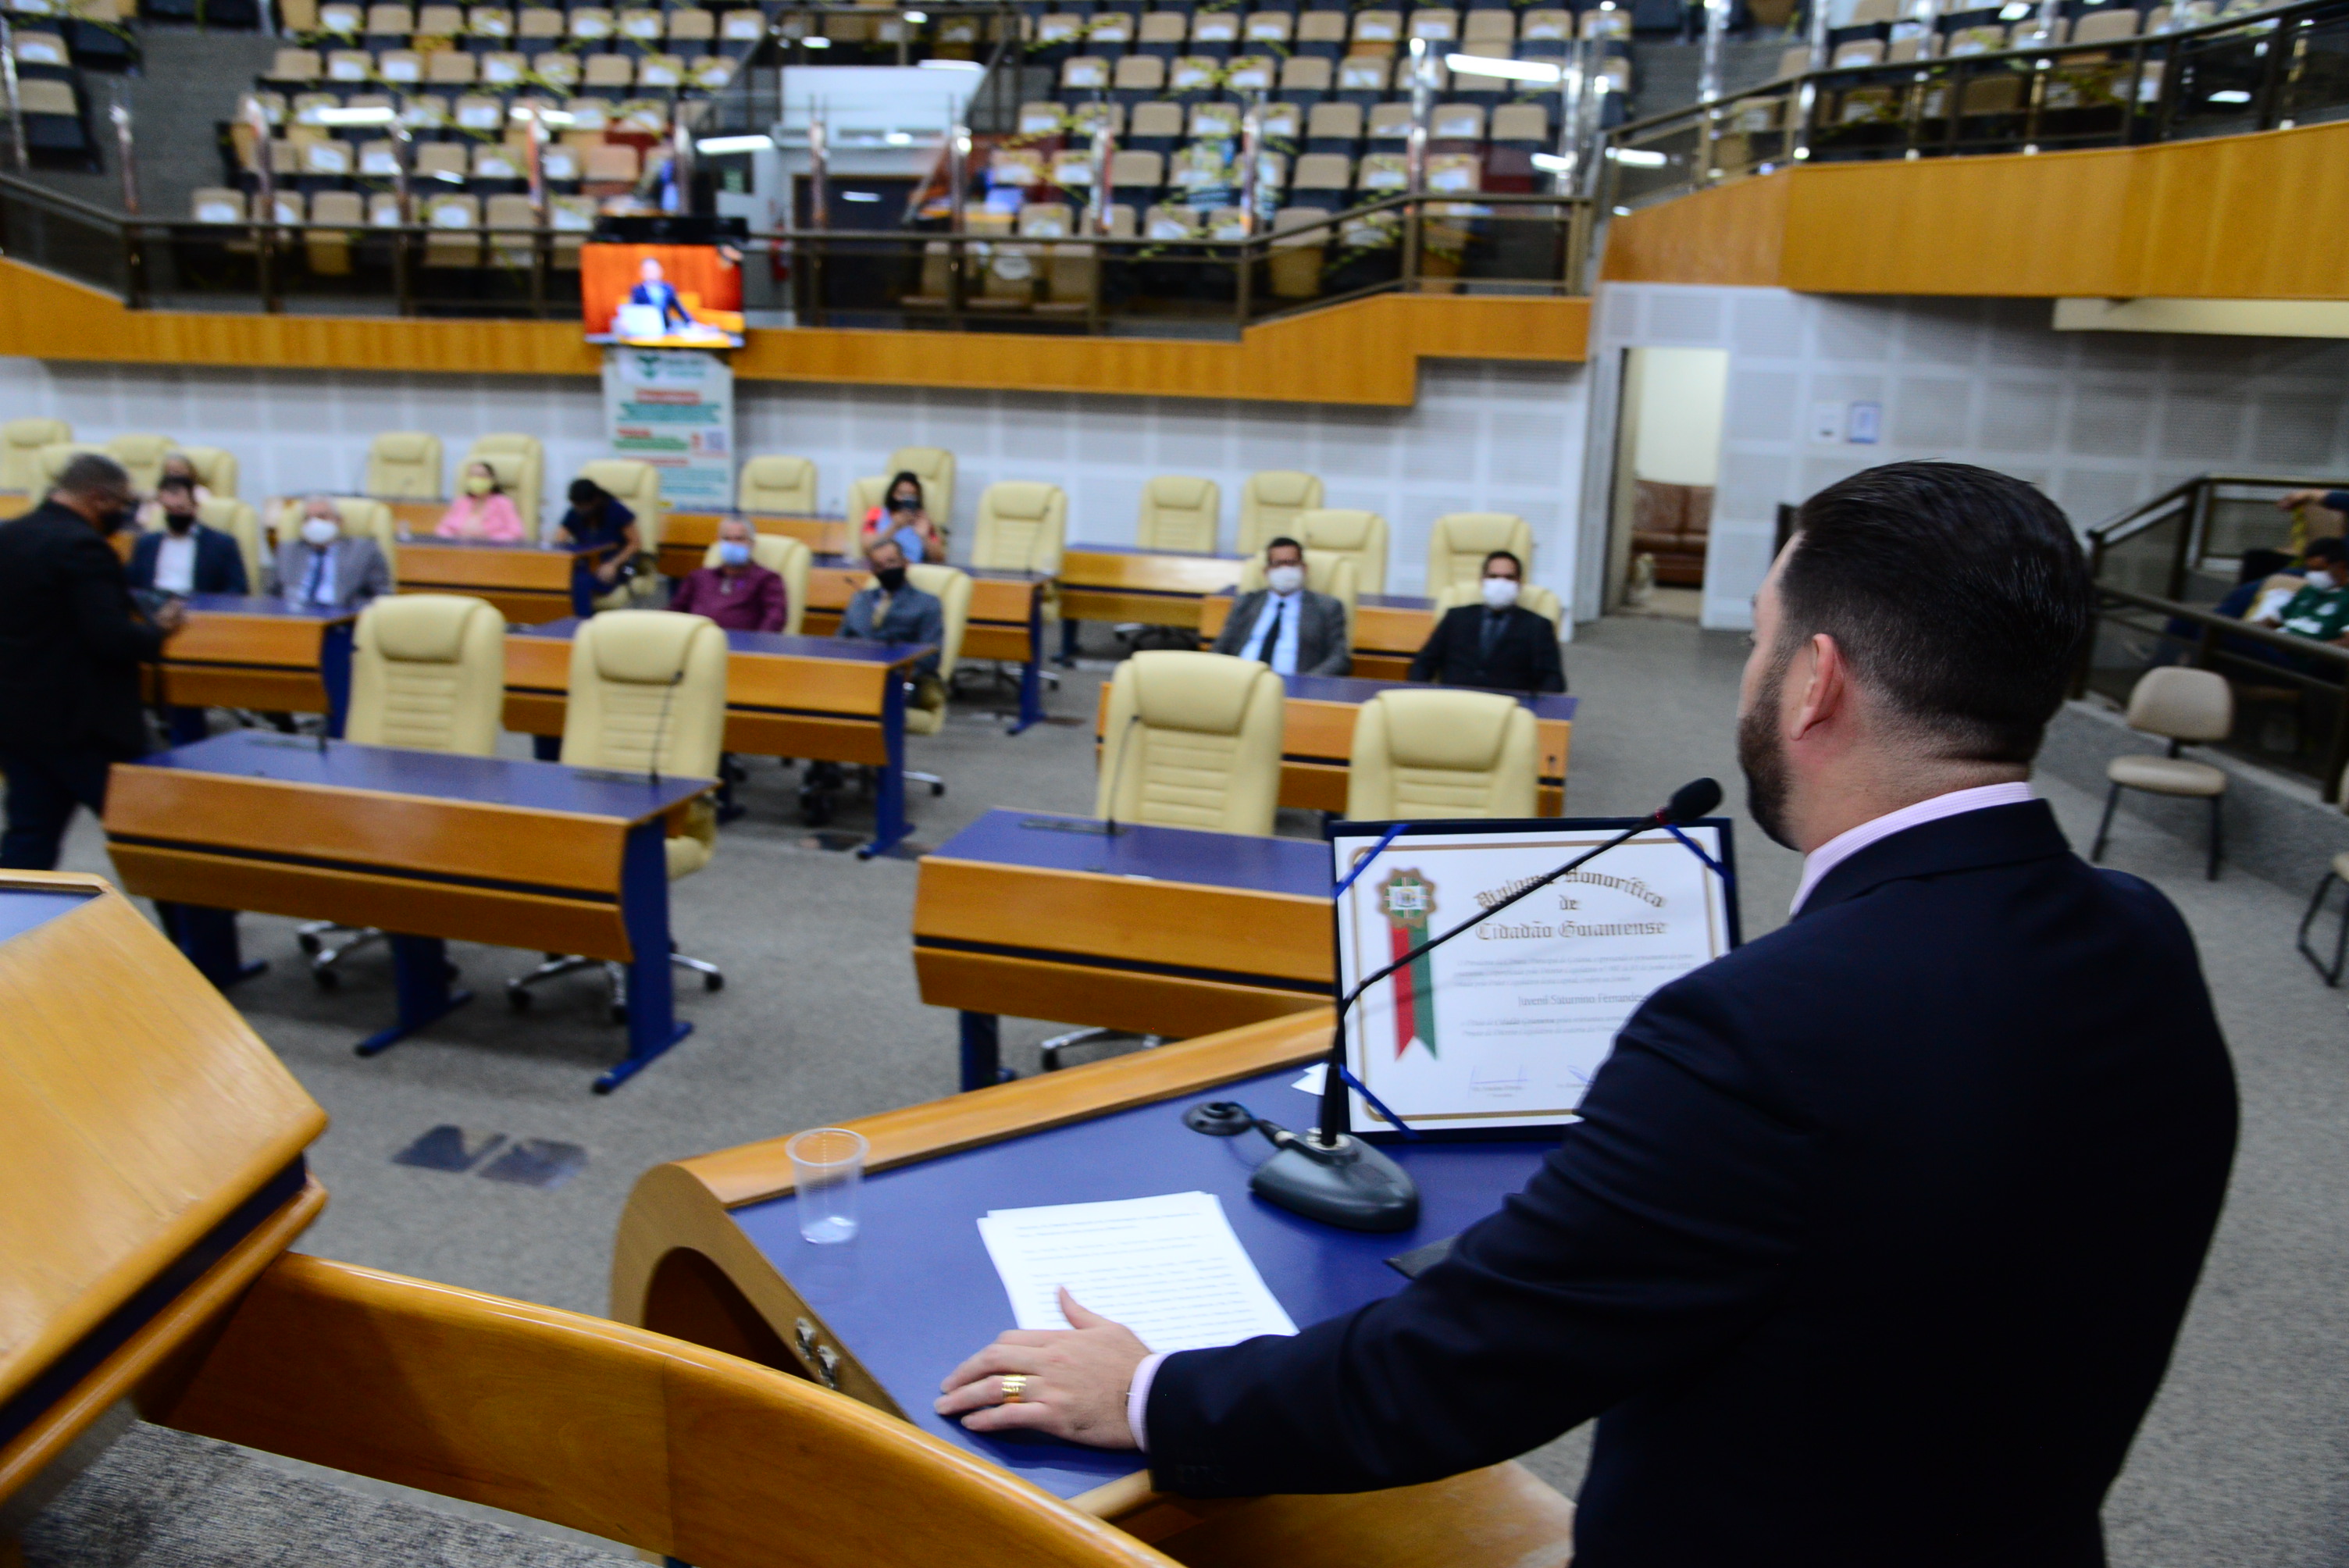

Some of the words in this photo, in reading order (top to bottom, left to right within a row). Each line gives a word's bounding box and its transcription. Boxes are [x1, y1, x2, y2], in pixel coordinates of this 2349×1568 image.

[1473, 875, 1554, 911] Diplom
[1559, 894, 1580, 911] de
[1475, 920, 1552, 940] Cidadão
[1558, 919, 1669, 939] Goianiense
